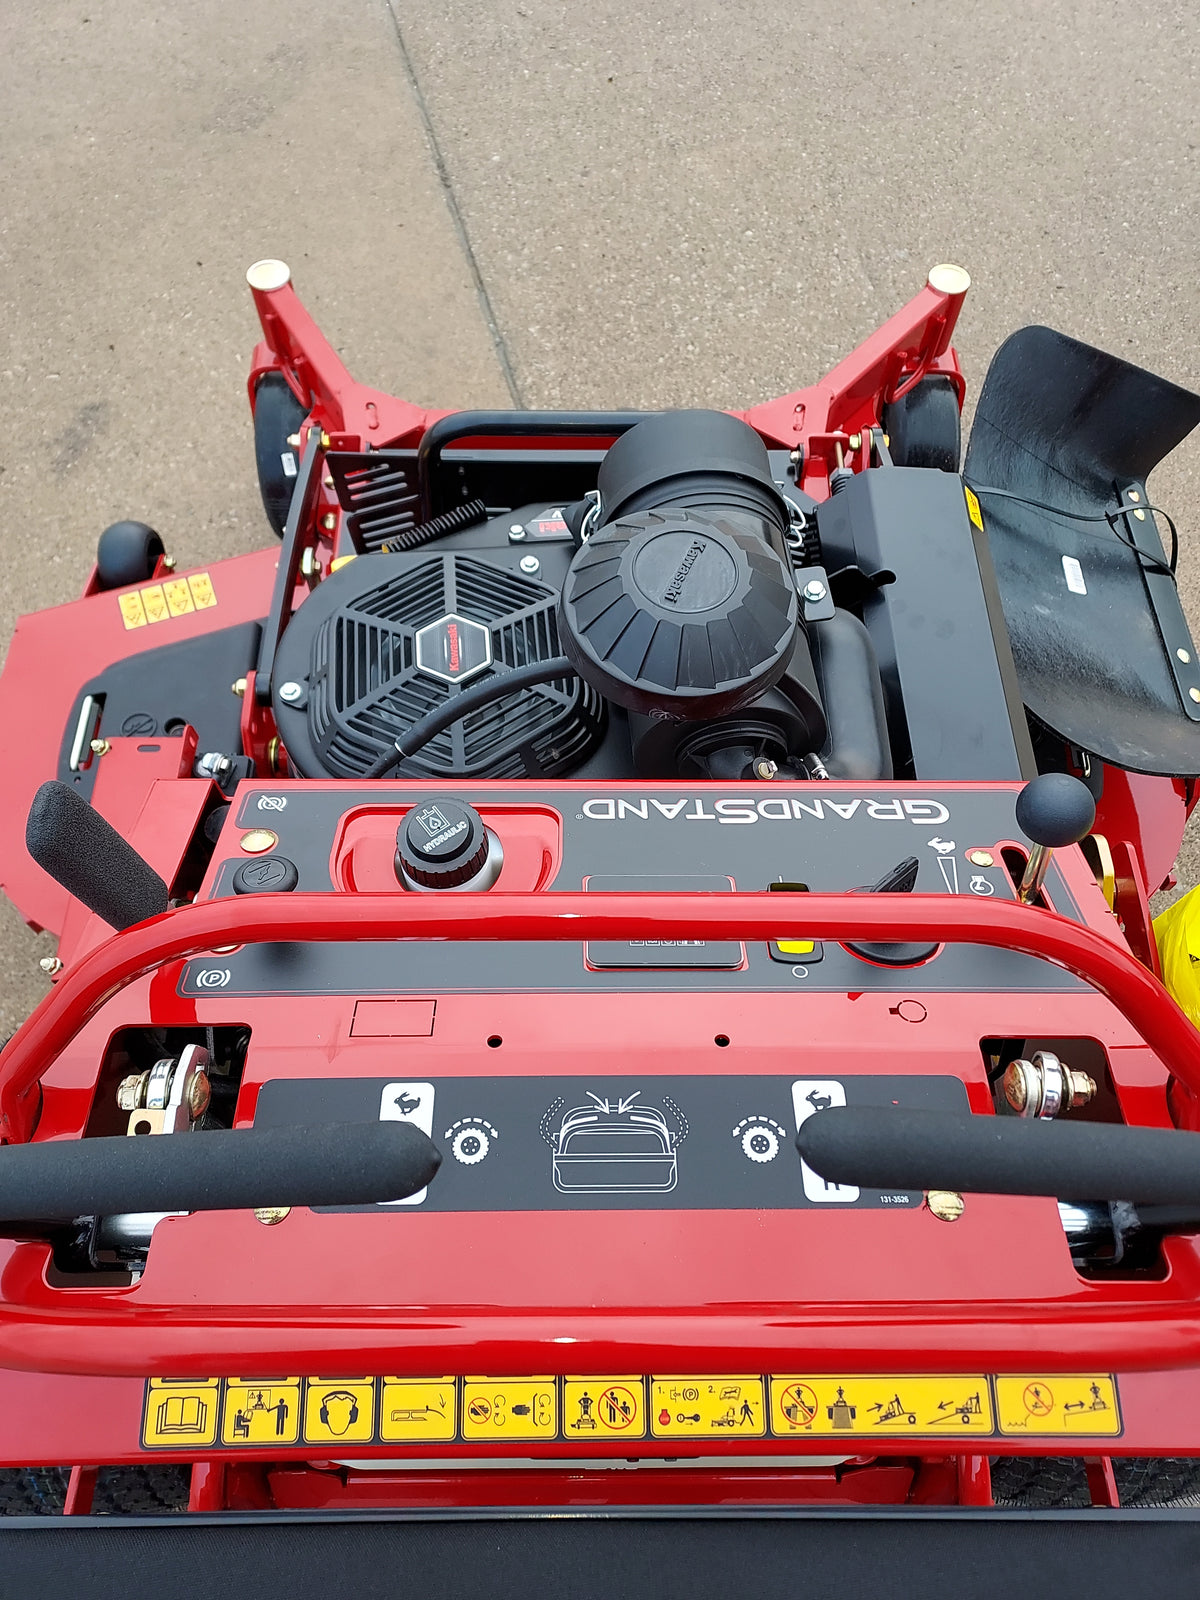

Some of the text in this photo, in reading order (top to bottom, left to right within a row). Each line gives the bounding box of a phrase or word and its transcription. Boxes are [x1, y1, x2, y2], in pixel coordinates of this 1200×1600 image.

[664, 540, 707, 604] Kawasaki
[447, 624, 459, 671] Kawasaki
[422, 820, 467, 853] HYDRAULIC
[880, 1195, 909, 1203] 131-3526
